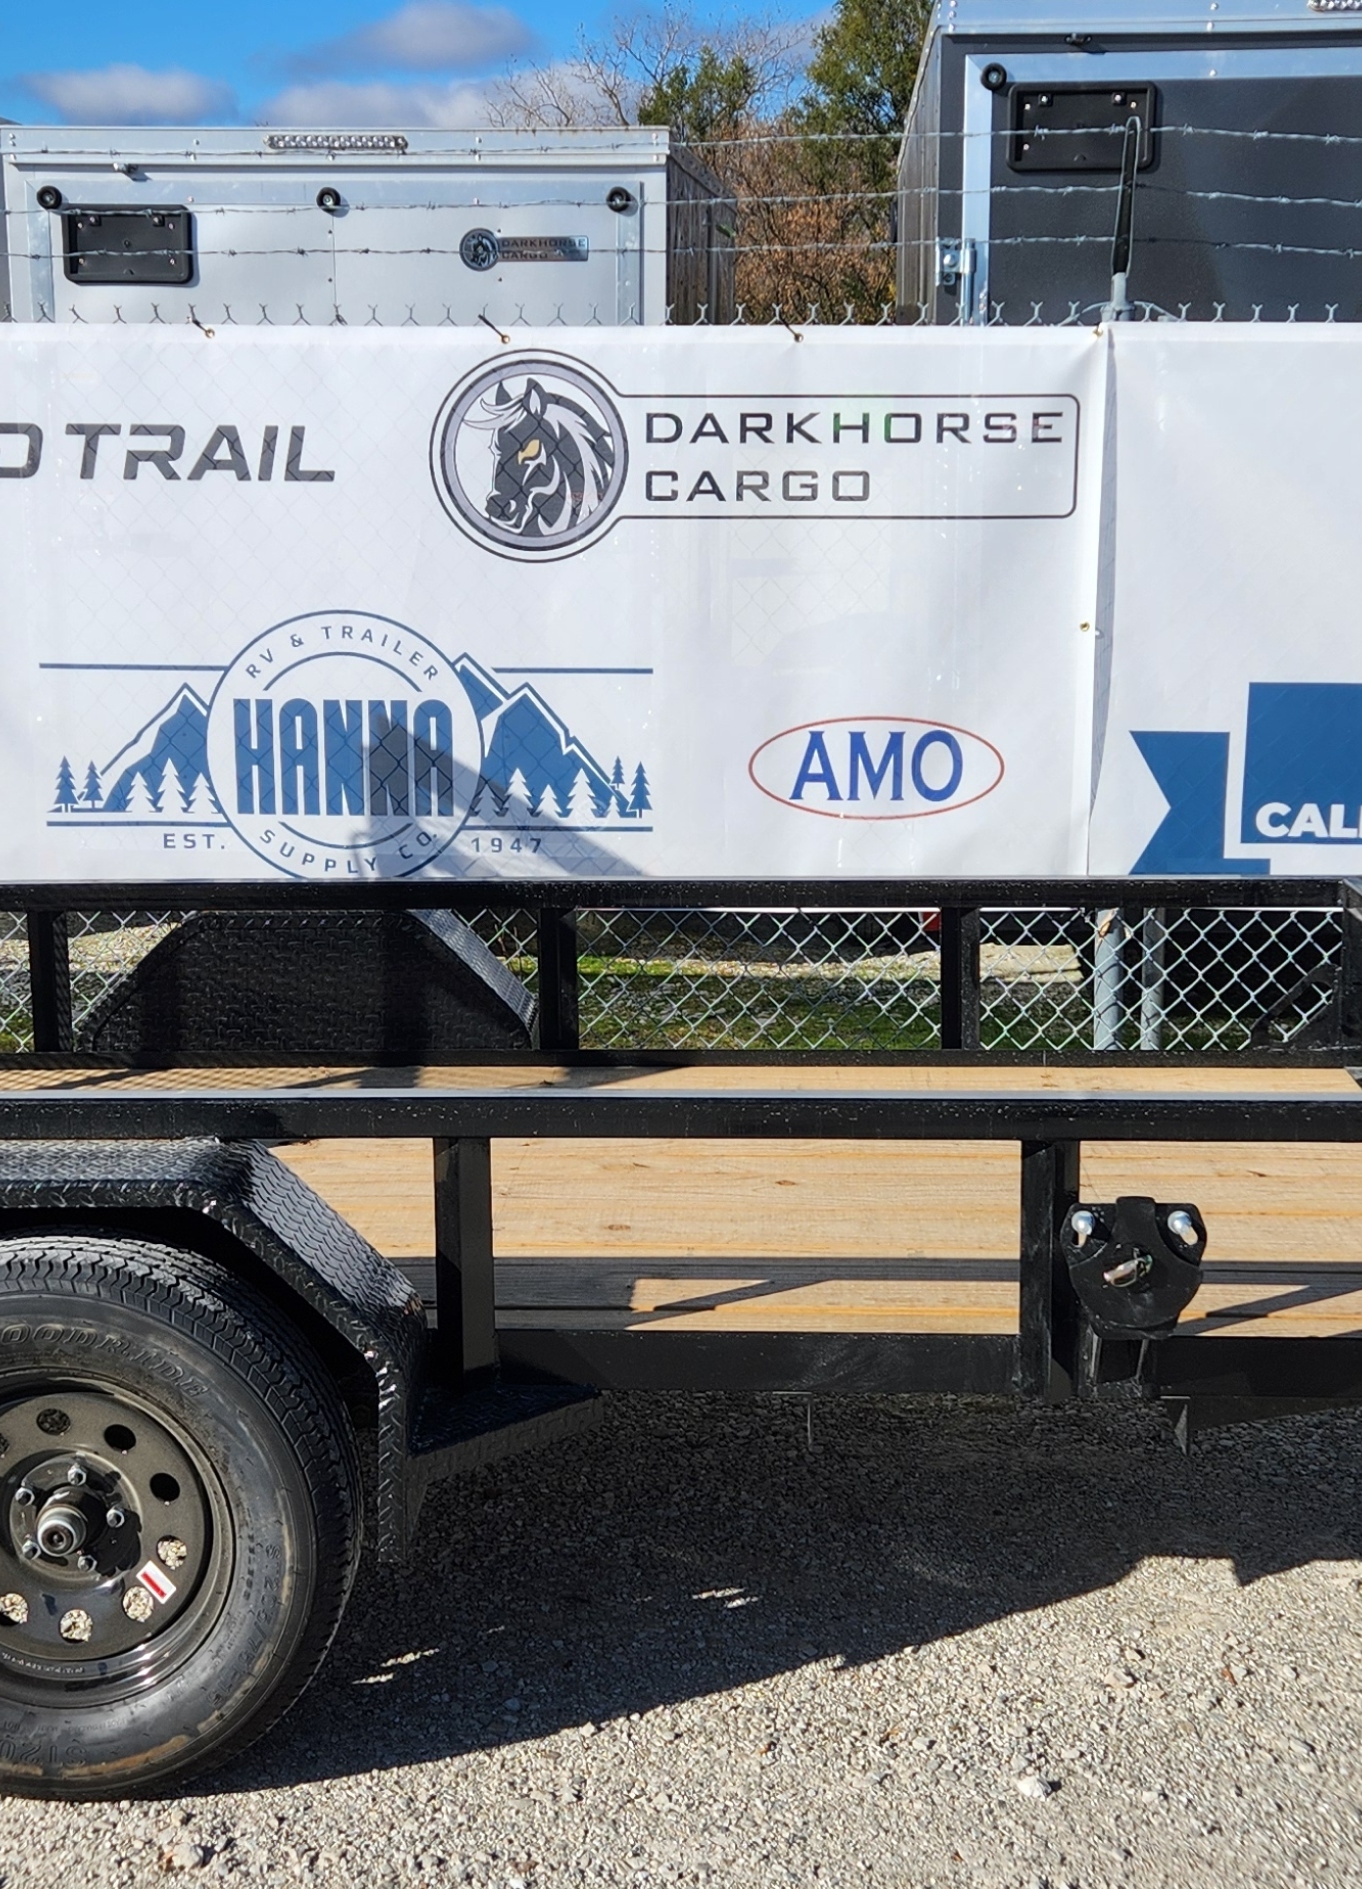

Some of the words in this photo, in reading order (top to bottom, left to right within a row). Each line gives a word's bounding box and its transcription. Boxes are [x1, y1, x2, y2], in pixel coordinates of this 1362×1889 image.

[502, 238, 586, 247] DARKHORSE
[645, 412, 1064, 444] DARKHORSE
[65, 423, 336, 482] TRAIL
[645, 470, 871, 502] CARGO
[245, 648, 275, 680] RV
[290, 634, 304, 648] &
[321, 625, 439, 681] TRAILER
[233, 698, 455, 817] HANNA
[788, 729, 964, 802] AMO
[162, 833, 226, 850] EST.
[470, 837, 543, 854] 1947
[260, 829, 378, 874] SUPPLY
[398, 832, 439, 860] CO.
